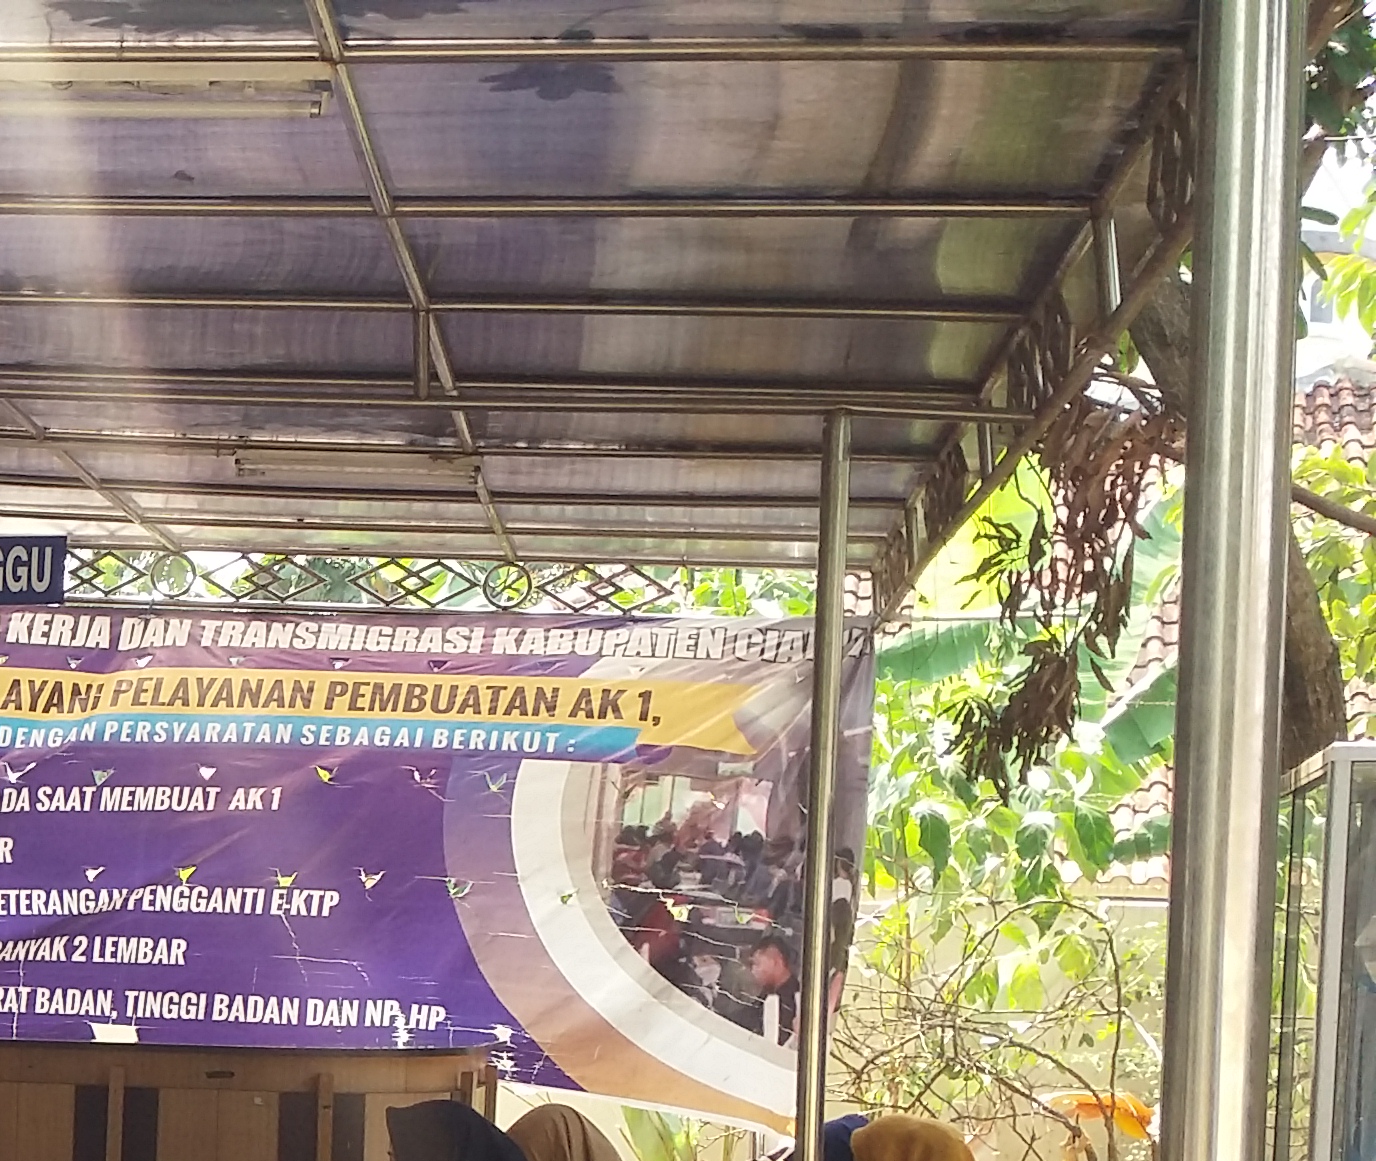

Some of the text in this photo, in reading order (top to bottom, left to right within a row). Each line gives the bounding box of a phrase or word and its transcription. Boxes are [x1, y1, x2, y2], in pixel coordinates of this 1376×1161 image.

[5, 611, 111, 649] KERJA
[117, 617, 192, 651] DAN
[200, 618, 484, 654] TRANSMIGRASI
[491, 626, 727, 660] KABUPATEN
[109, 677, 315, 711] PELAYANAN
[324, 680, 560, 719] PEMBUATAN
[569, 688, 628, 720] AK
[103, 721, 295, 745] PERSYARATAN
[300, 725, 423, 749] SEBAGAI
[431, 730, 563, 753] BERIKUT
[36, 785, 96, 812] SAAT
[99, 786, 220, 812] MEMBUAT
[227, 786, 266, 811] AK
[270, 786, 283, 811] 1
[127, 885, 266, 915] PENGGANTI
[269, 888, 341, 917] E-KTP
[71, 937, 87, 962] 2
[91, 937, 188, 966] LEMBAR
[124, 990, 206, 1020] TINGGI
[217, 993, 300, 1024] BADAN
[306, 997, 359, 1027] DAN
[409, 1003, 446, 1030] HP
